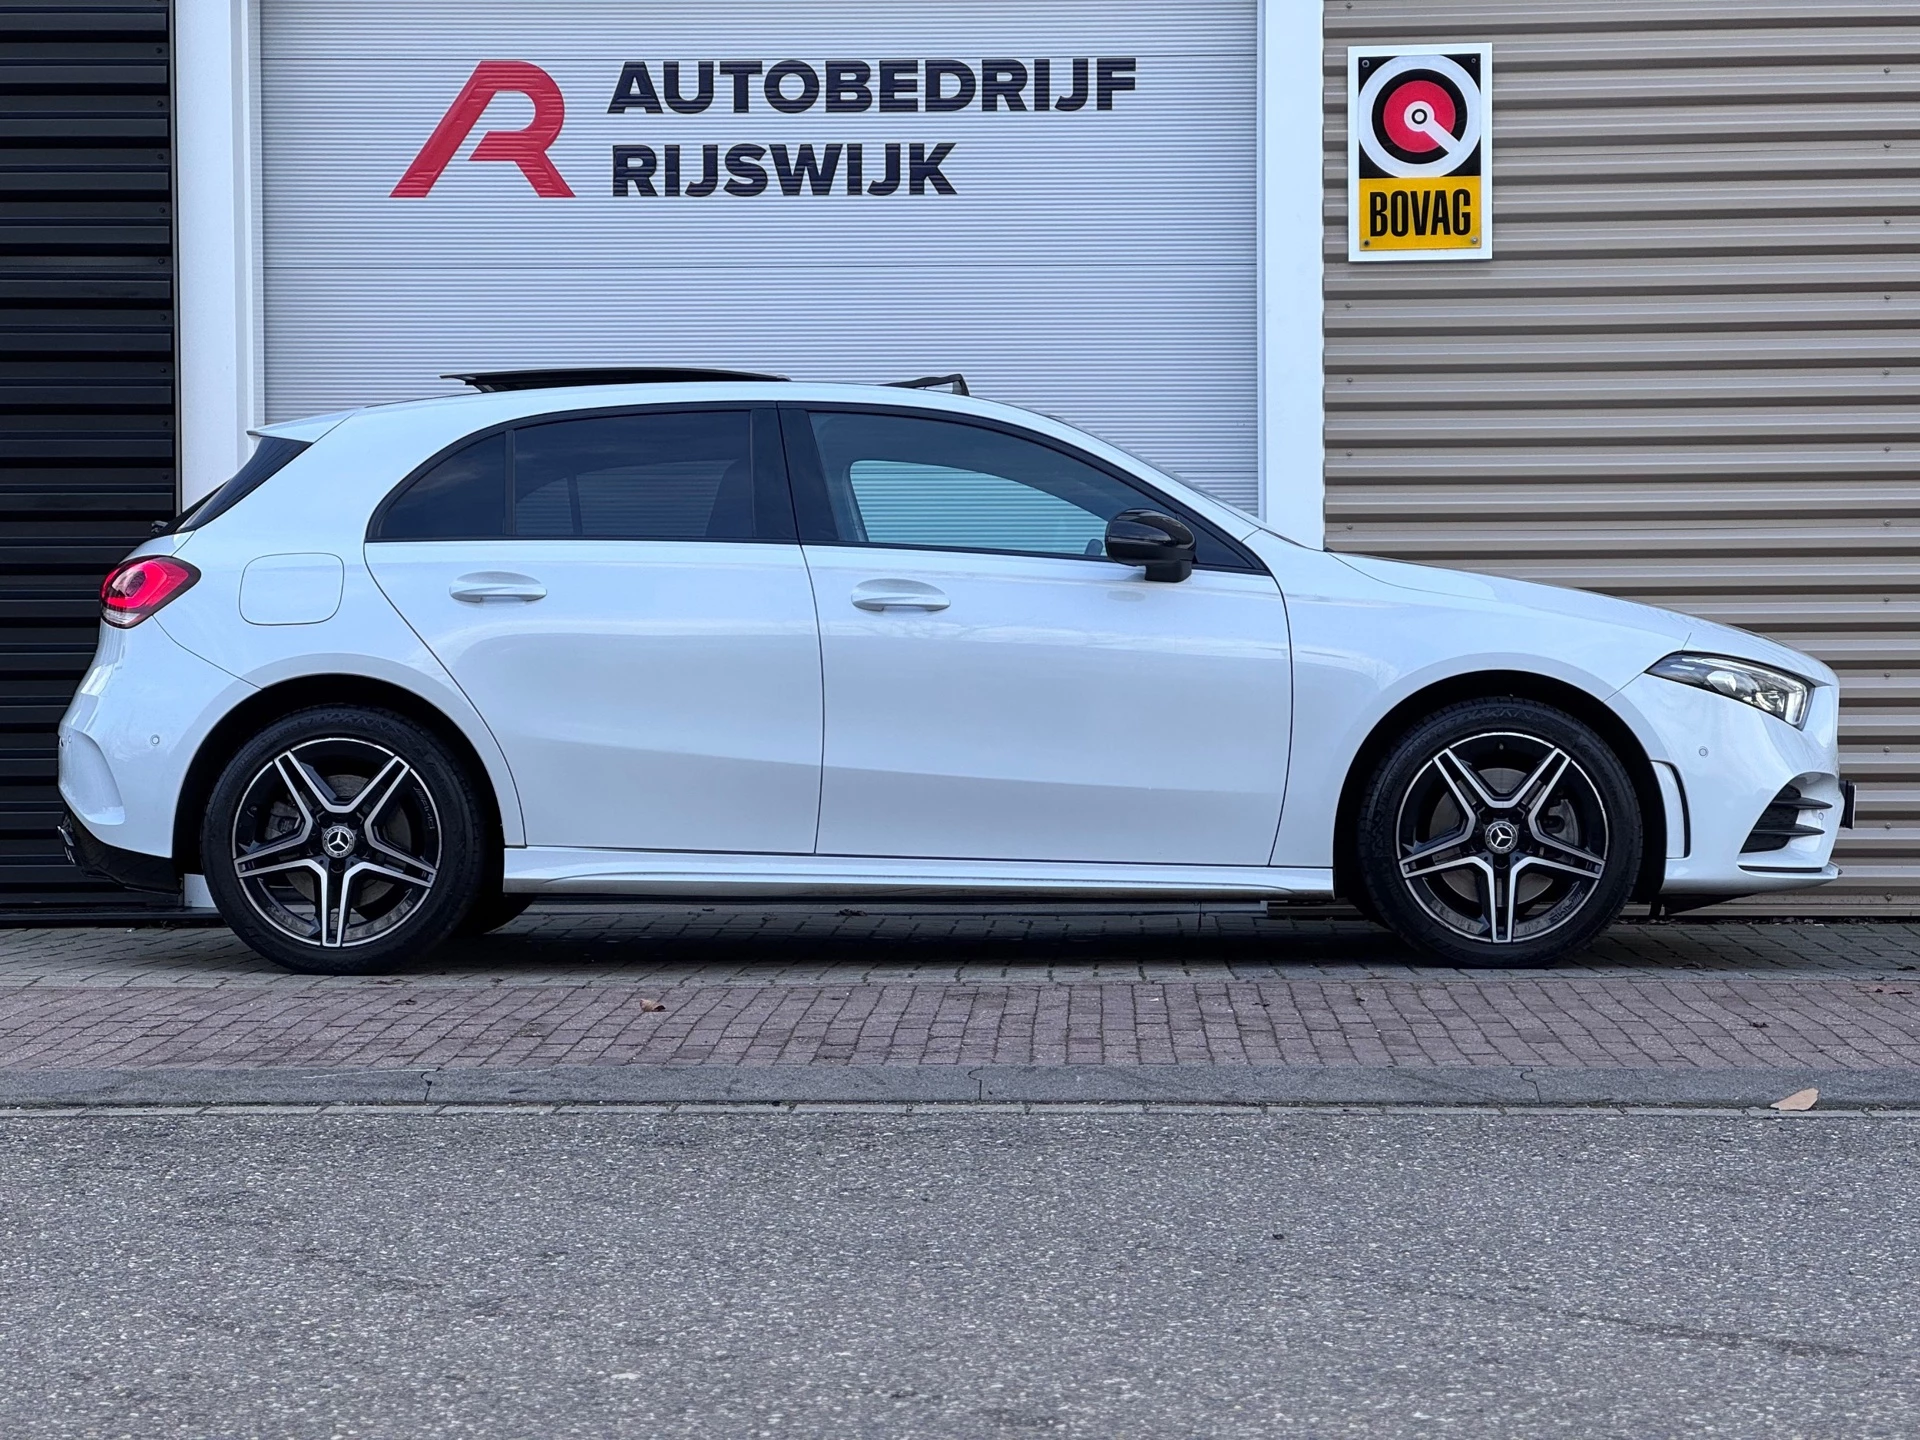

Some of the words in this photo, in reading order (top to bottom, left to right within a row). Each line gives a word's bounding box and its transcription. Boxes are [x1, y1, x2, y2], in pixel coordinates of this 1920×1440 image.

[607, 57, 1137, 114] AUTOBEDRIJF
[612, 143, 957, 197] RIJSWIJK
[1370, 189, 1471, 237] BOVAG
